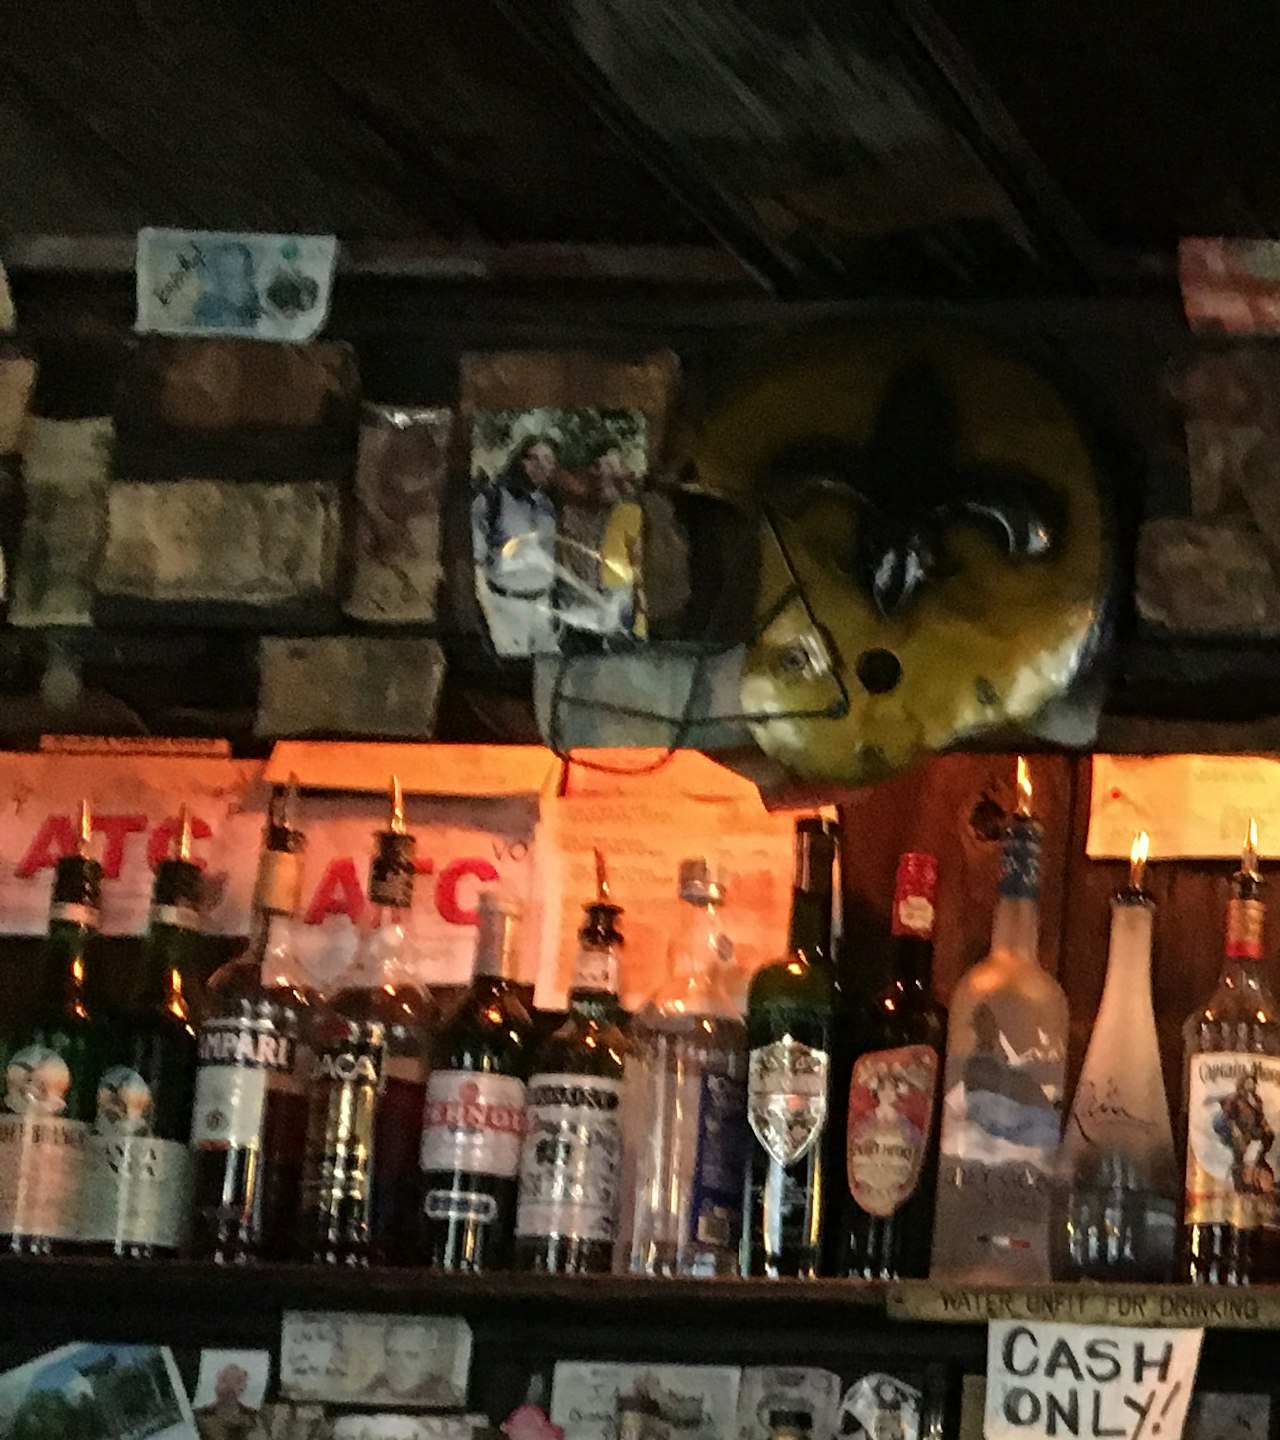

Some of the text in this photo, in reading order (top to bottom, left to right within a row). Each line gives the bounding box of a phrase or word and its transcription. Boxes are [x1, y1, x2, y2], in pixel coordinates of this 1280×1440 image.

[14, 813, 213, 881] ATC
[304, 855, 500, 926] AC
[939, 1290, 1011, 1314] WATER
[1104, 1295, 1146, 1317] FOR
[1160, 1297, 1261, 1319] DRINKING
[1001, 1325, 1173, 1383] CASH
